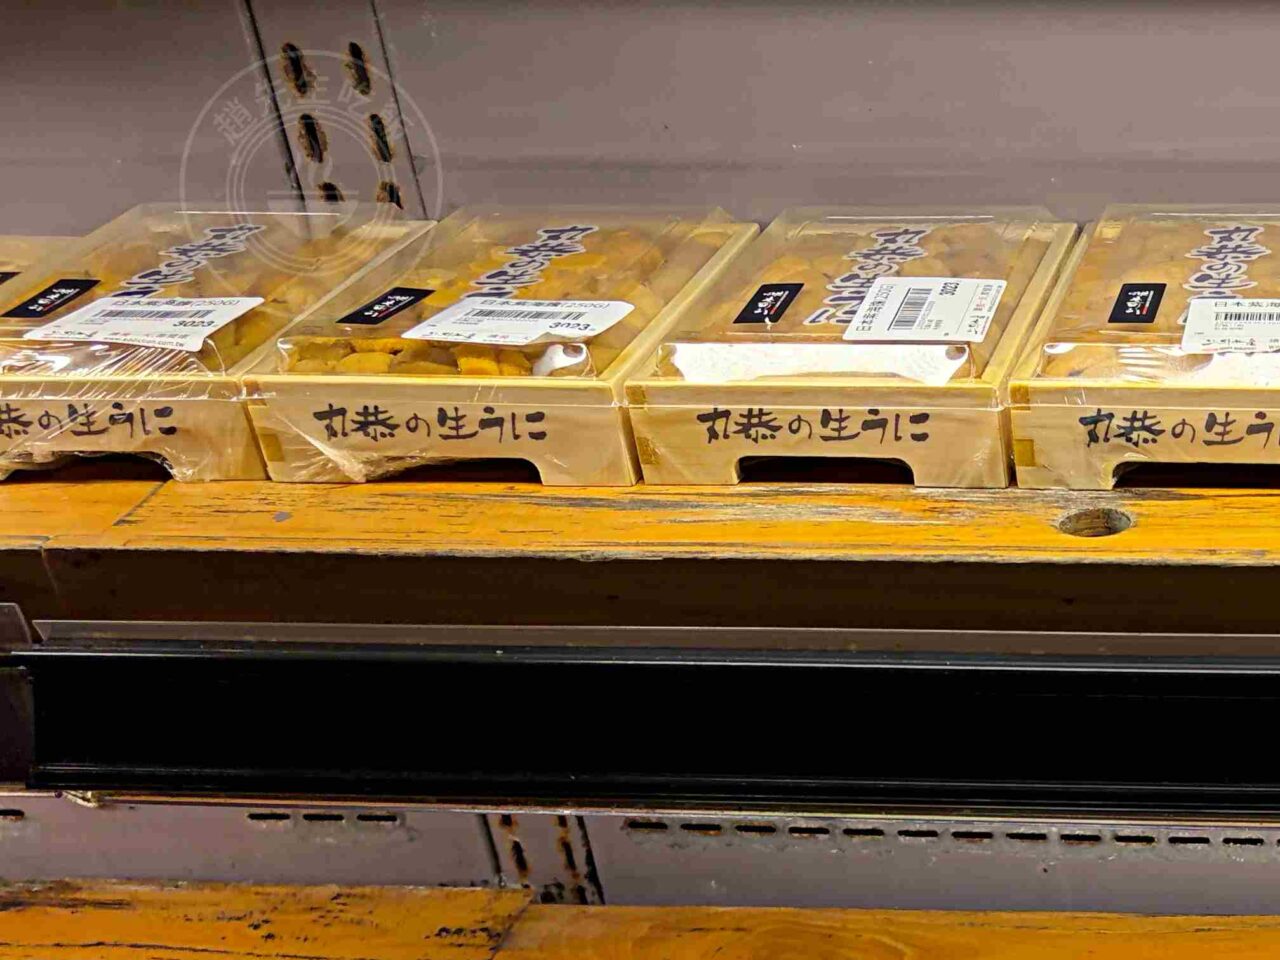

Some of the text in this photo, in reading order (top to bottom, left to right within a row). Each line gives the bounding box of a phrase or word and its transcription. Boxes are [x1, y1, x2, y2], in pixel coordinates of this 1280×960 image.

[313, 402, 547, 442] 丸恭の生うに
[696, 407, 931, 444] 丸恭の生うに
